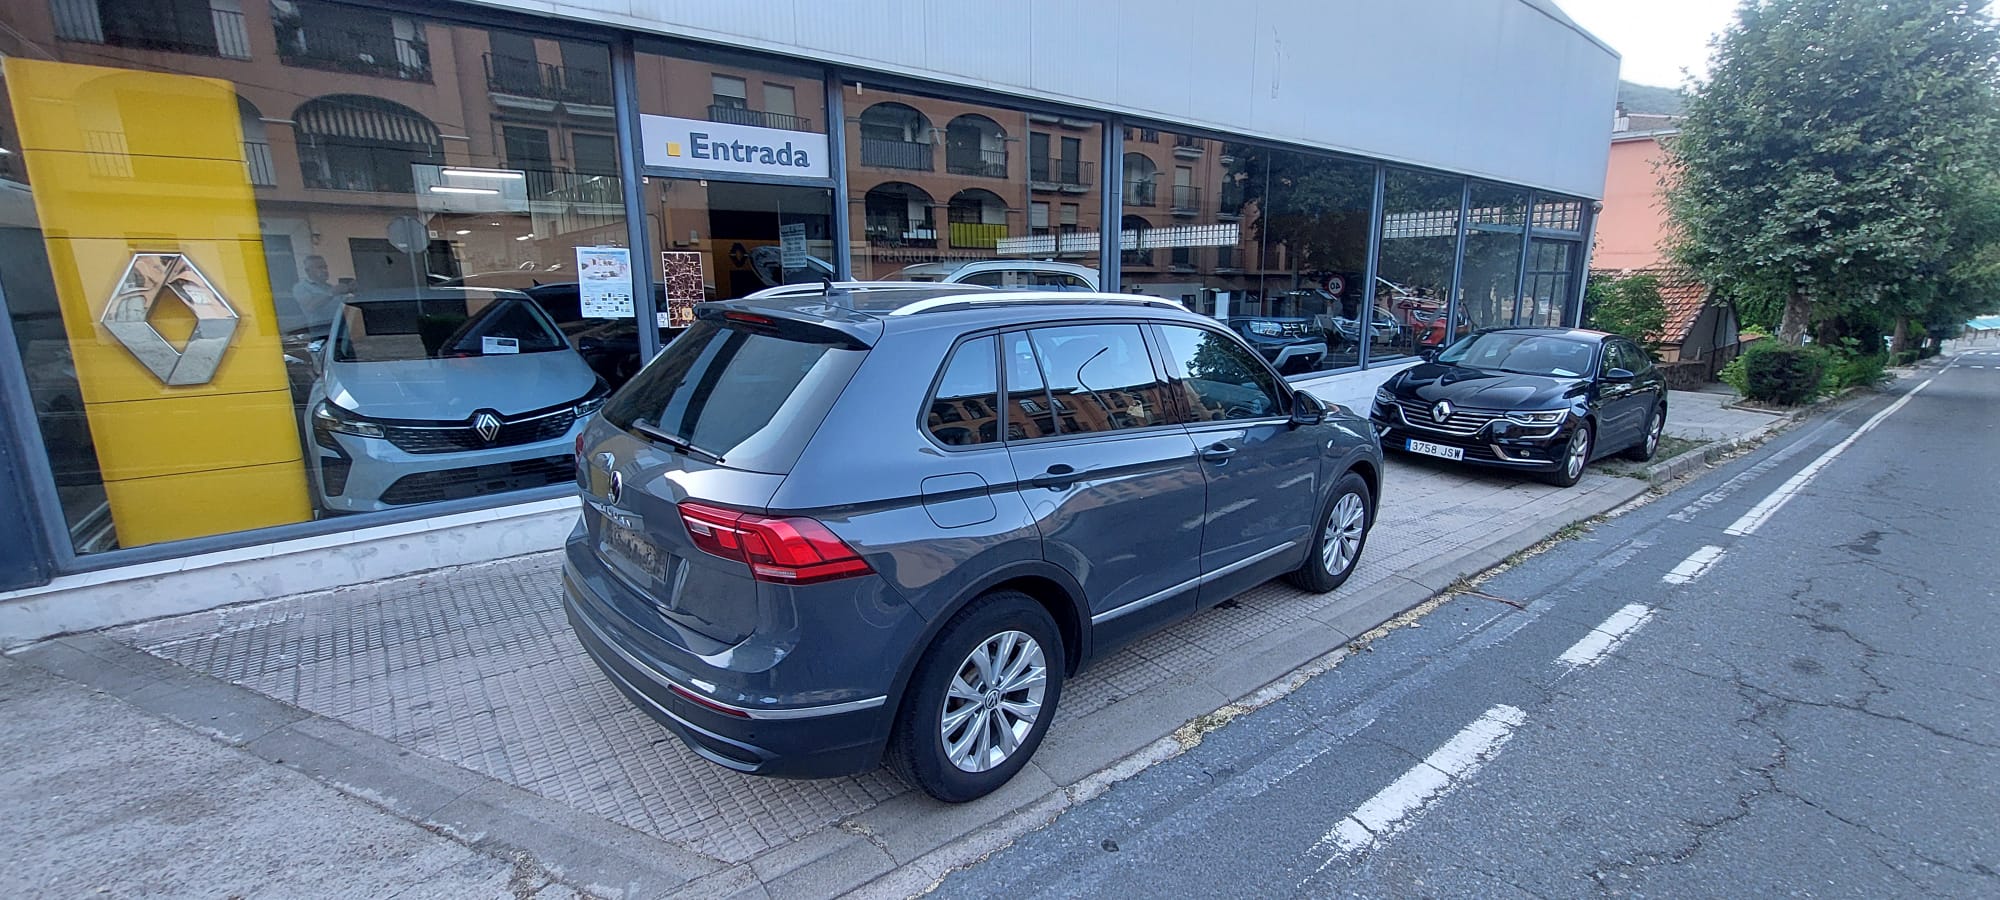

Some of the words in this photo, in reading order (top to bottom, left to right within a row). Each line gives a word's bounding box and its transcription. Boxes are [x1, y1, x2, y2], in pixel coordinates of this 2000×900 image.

[690, 132, 810, 167] Entrada
[879, 250, 936, 262] RENAULT
[1412, 441, 1437, 454] 3758
[1440, 448, 1461, 459] JSW
